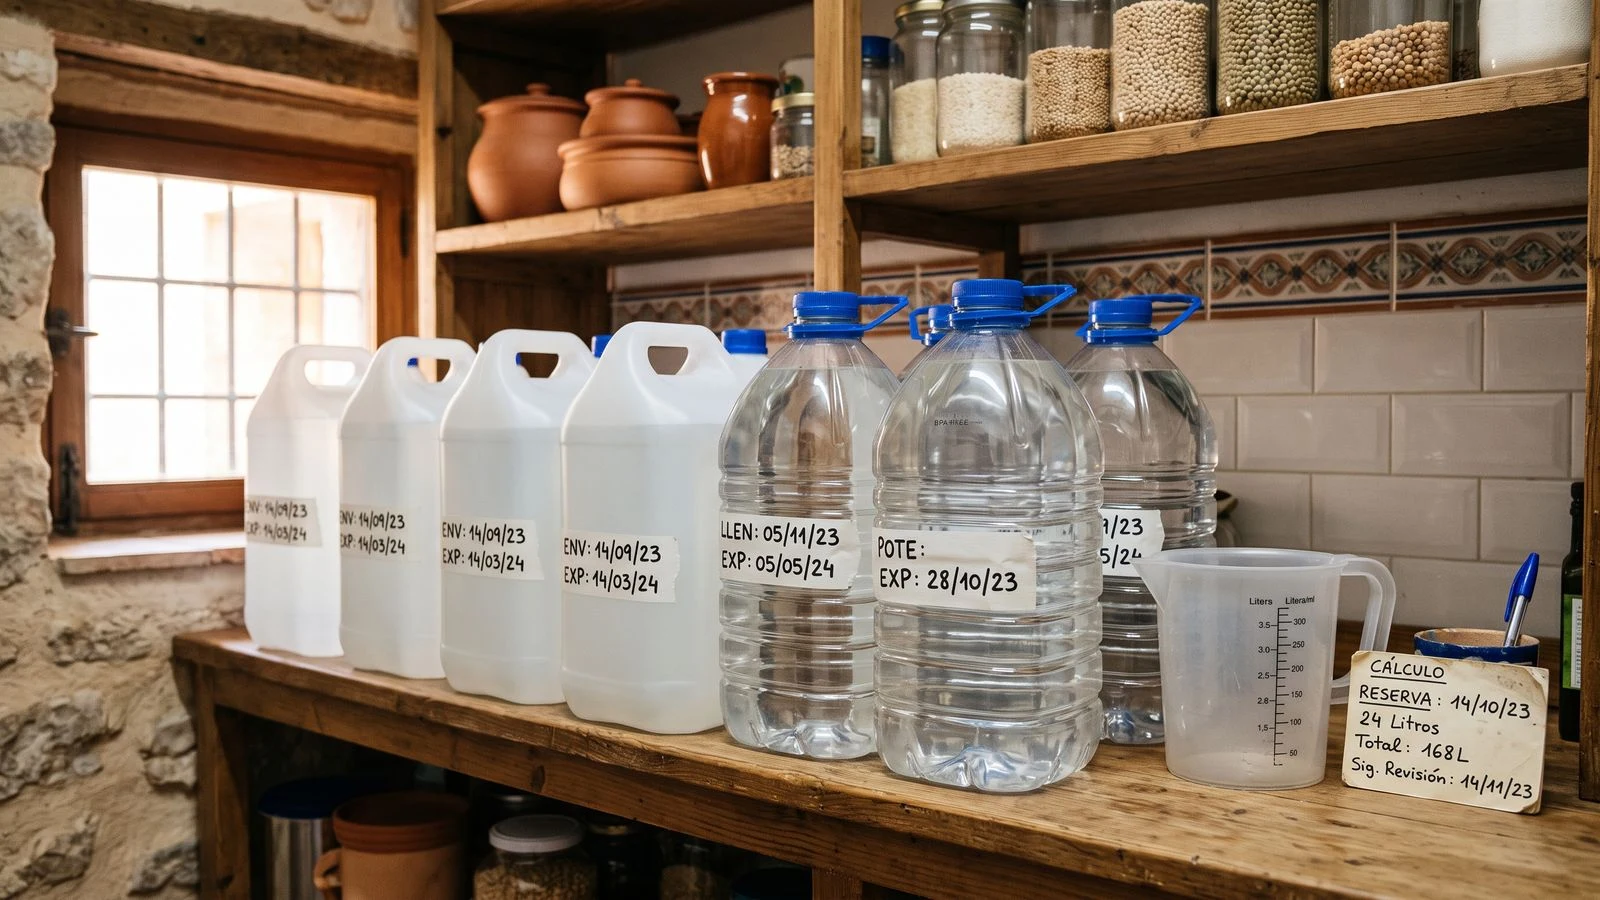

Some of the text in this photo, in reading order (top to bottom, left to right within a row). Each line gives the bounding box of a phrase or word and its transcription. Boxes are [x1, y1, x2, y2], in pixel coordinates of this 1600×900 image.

[358, 510, 405, 531] 14/09/23
[358, 533, 405, 556] 14/03/24
[442, 522, 526, 547] ENV: 14/09/23
[720, 520, 840, 549] LLEN: 05/11/23
[563, 537, 662, 566] ENV: 14/09/23
[877, 536, 925, 560] POTE:
[442, 548, 524, 574] EXP: 14/03/24
[721, 550, 834, 581] EXP: 05/05/24
[564, 566, 659, 596] EXP: 14/03/24
[880, 566, 1018, 597] EXP: 28/10/23
[1249, 597, 1273, 605] Liters
[1258, 621, 1271, 629] 3.5
[1370, 656, 1444, 678] CÁLCULO
[1450, 693, 1531, 719] 14/10/23
[1359, 711, 1440, 735] 24 Litros
[1351, 757, 1379, 779] Sig.
[1460, 774, 1533, 799] 14/11/23
